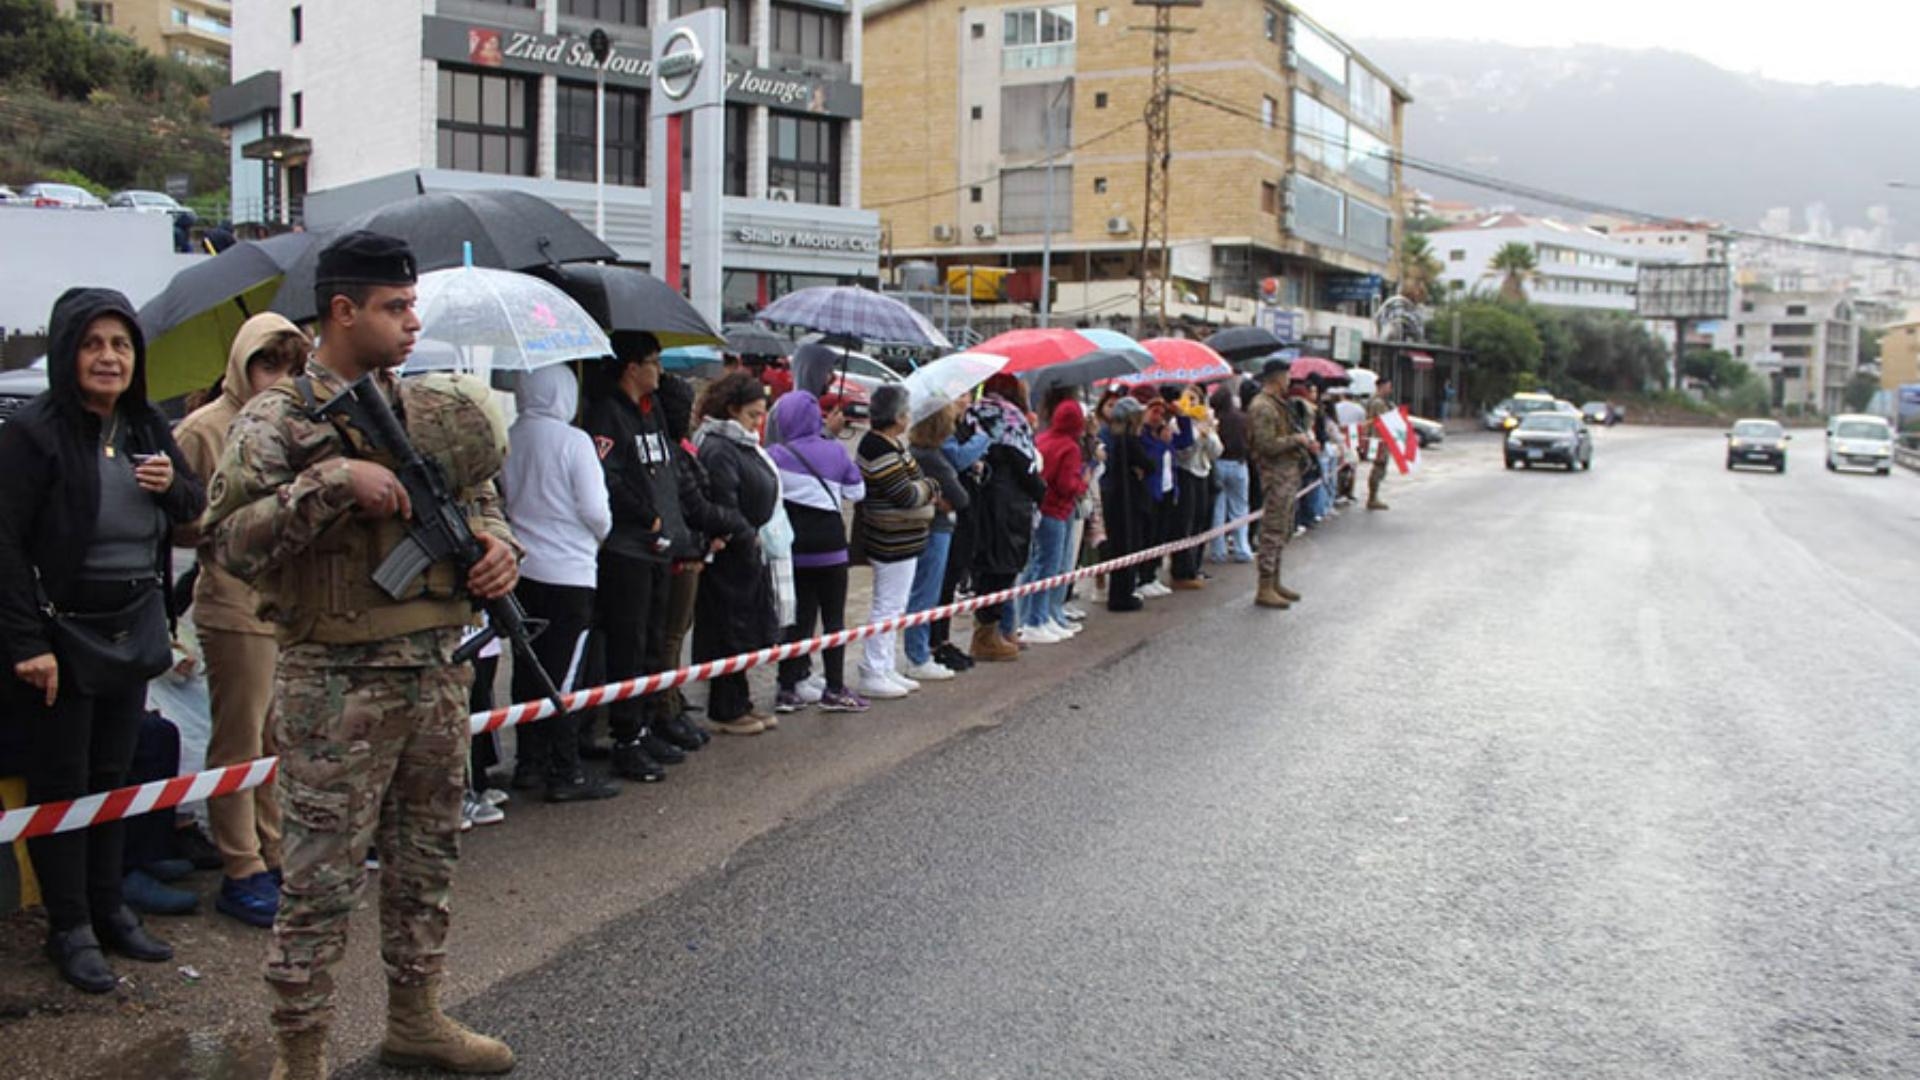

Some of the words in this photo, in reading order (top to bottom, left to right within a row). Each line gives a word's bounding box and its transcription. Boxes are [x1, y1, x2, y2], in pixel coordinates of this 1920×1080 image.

[504, 32, 566, 63] Ziad
[566, 42, 653, 76] Saloun
[739, 69, 808, 103] lounge
